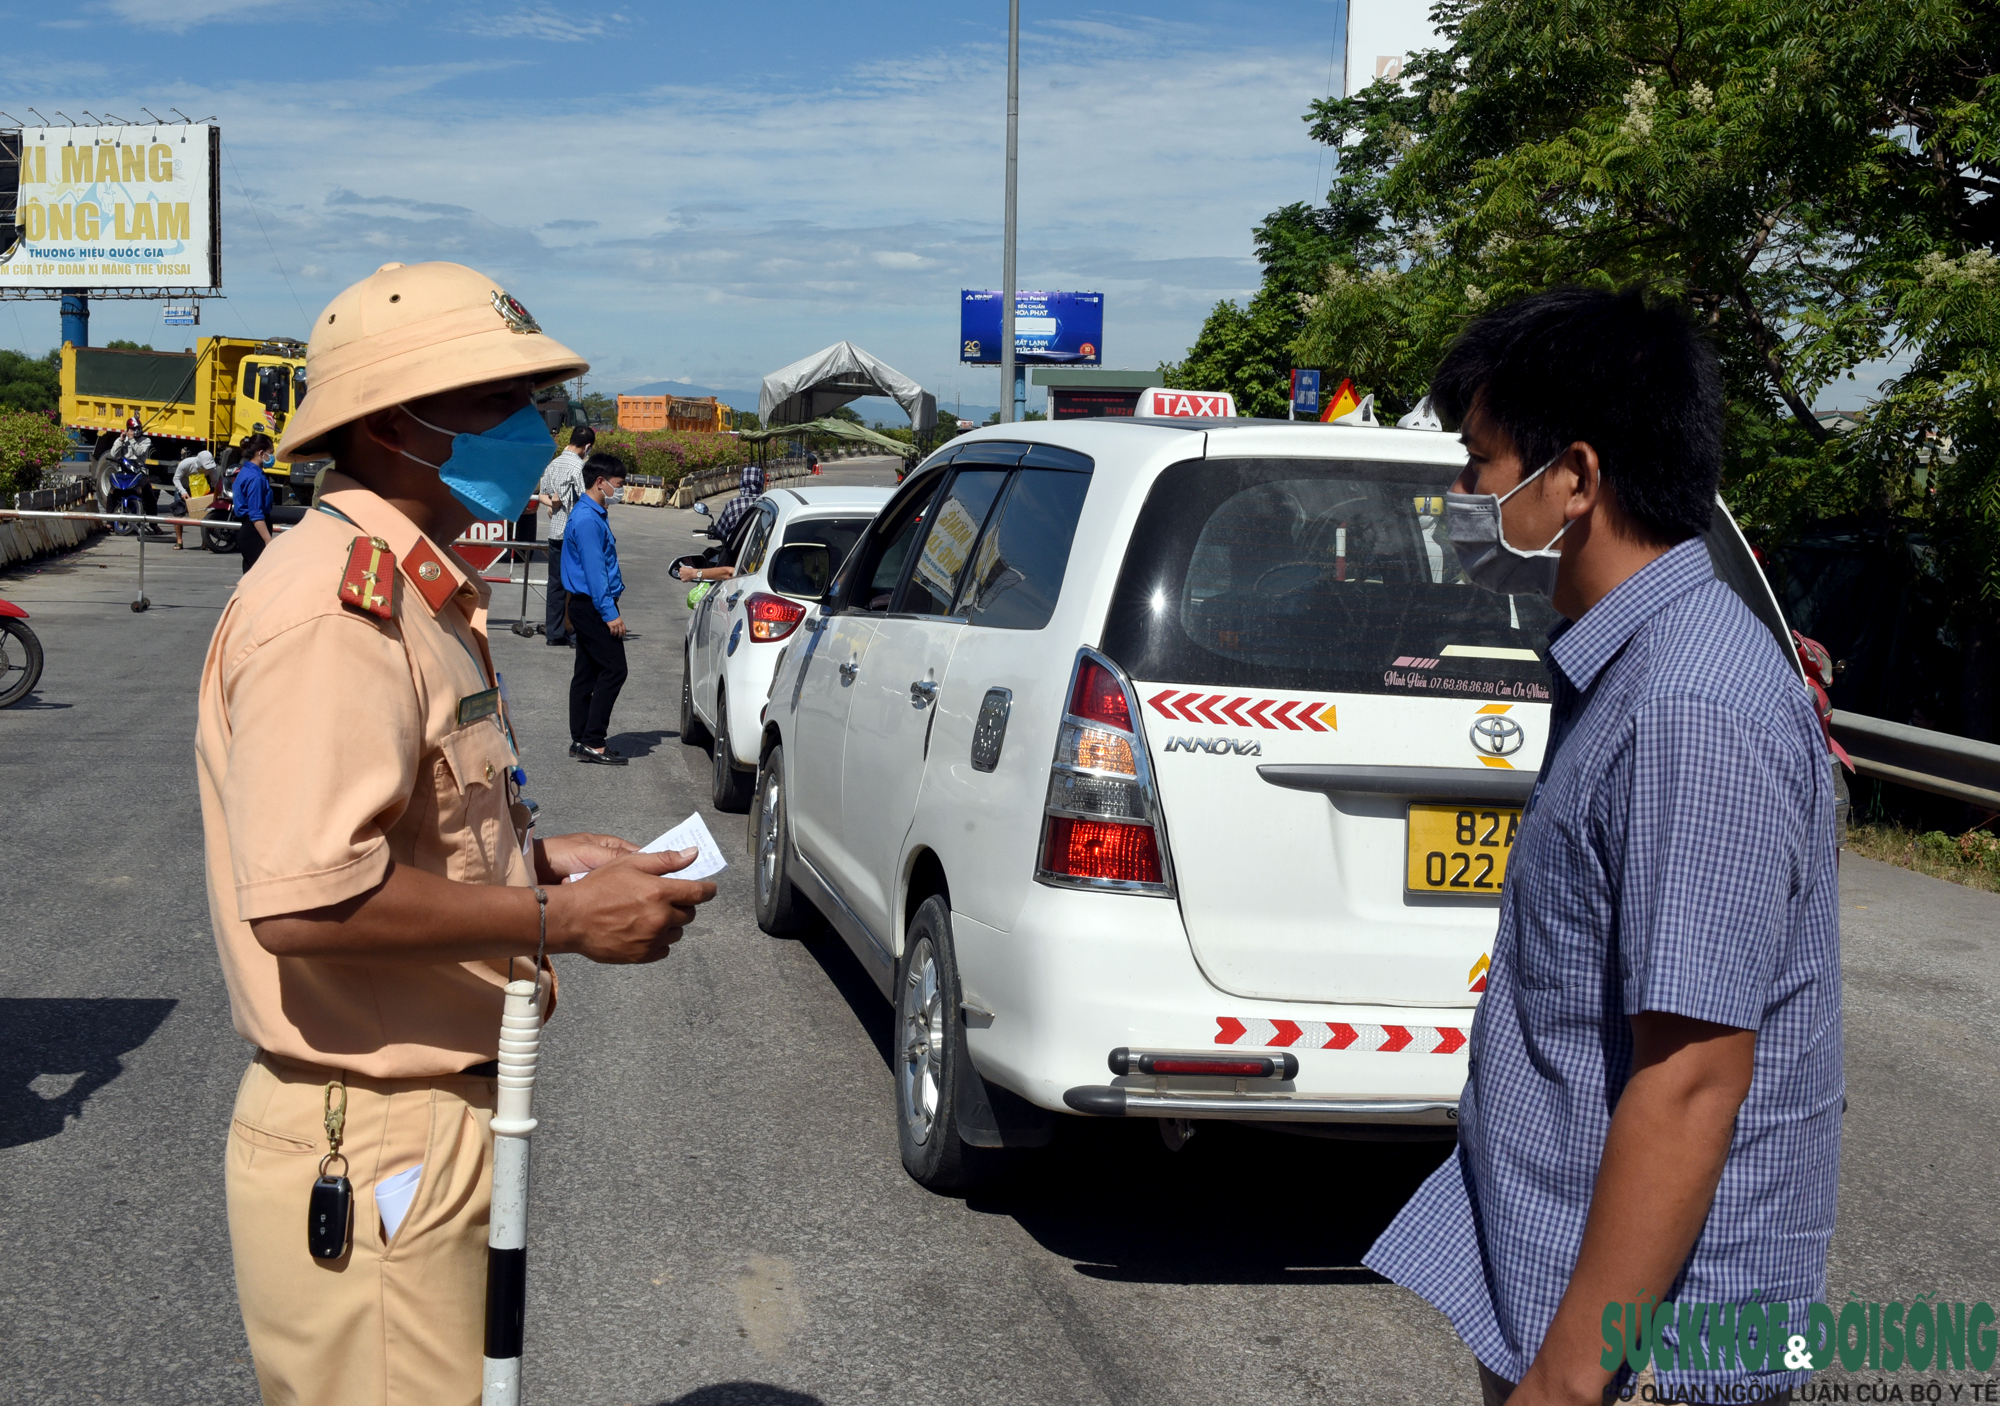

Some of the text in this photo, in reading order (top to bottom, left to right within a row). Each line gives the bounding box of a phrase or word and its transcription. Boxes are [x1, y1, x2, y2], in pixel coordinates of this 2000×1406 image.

[61, 138, 173, 183] MĂNG
[17, 197, 190, 241] ÔNG LAM
[79, 246, 105, 260] HIỆU
[109, 245, 140, 258] QUỐC
[144, 248, 164, 258] GIA
[13, 262, 33, 275] CỦA
[36, 262, 55, 277] TẬP
[58, 263, 85, 275] ĐOÀN
[88, 264, 98, 275] XI
[102, 263, 131, 275] MĂNG
[135, 264, 153, 275] THE
[157, 264, 190, 275] VISSAI
[1157, 394, 1224, 417] TAXI
[459, 522, 504, 541] OP
[1384, 670, 1406, 687] Minh
[1164, 735, 1262, 756] INNOVA
[1456, 811, 1519, 848] 82A
